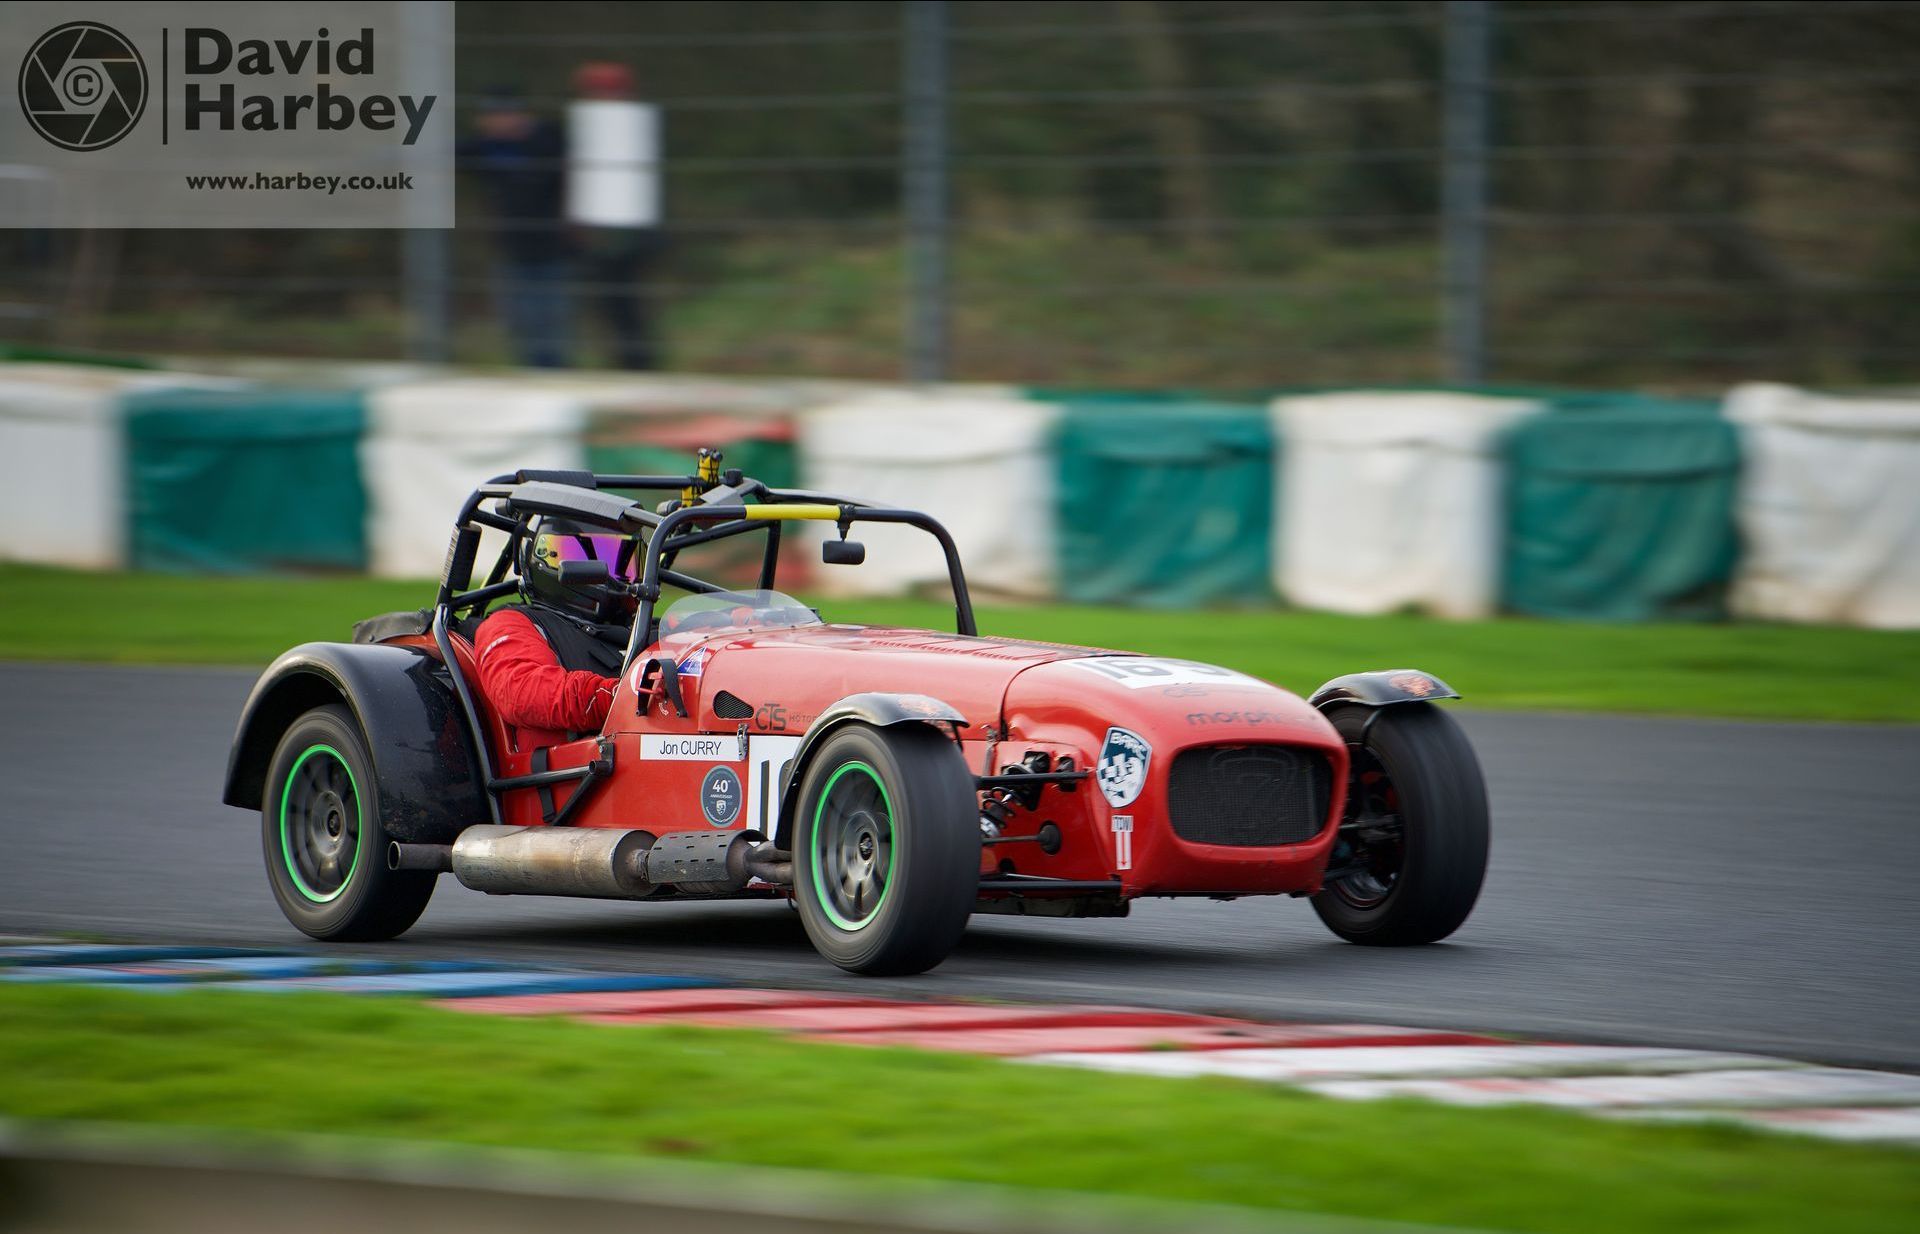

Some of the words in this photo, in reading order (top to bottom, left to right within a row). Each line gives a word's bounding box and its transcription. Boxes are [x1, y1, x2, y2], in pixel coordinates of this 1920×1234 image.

[755, 703, 786, 731] CTS
[660, 741, 678, 755] Jon
[681, 741, 721, 755] CURRY
